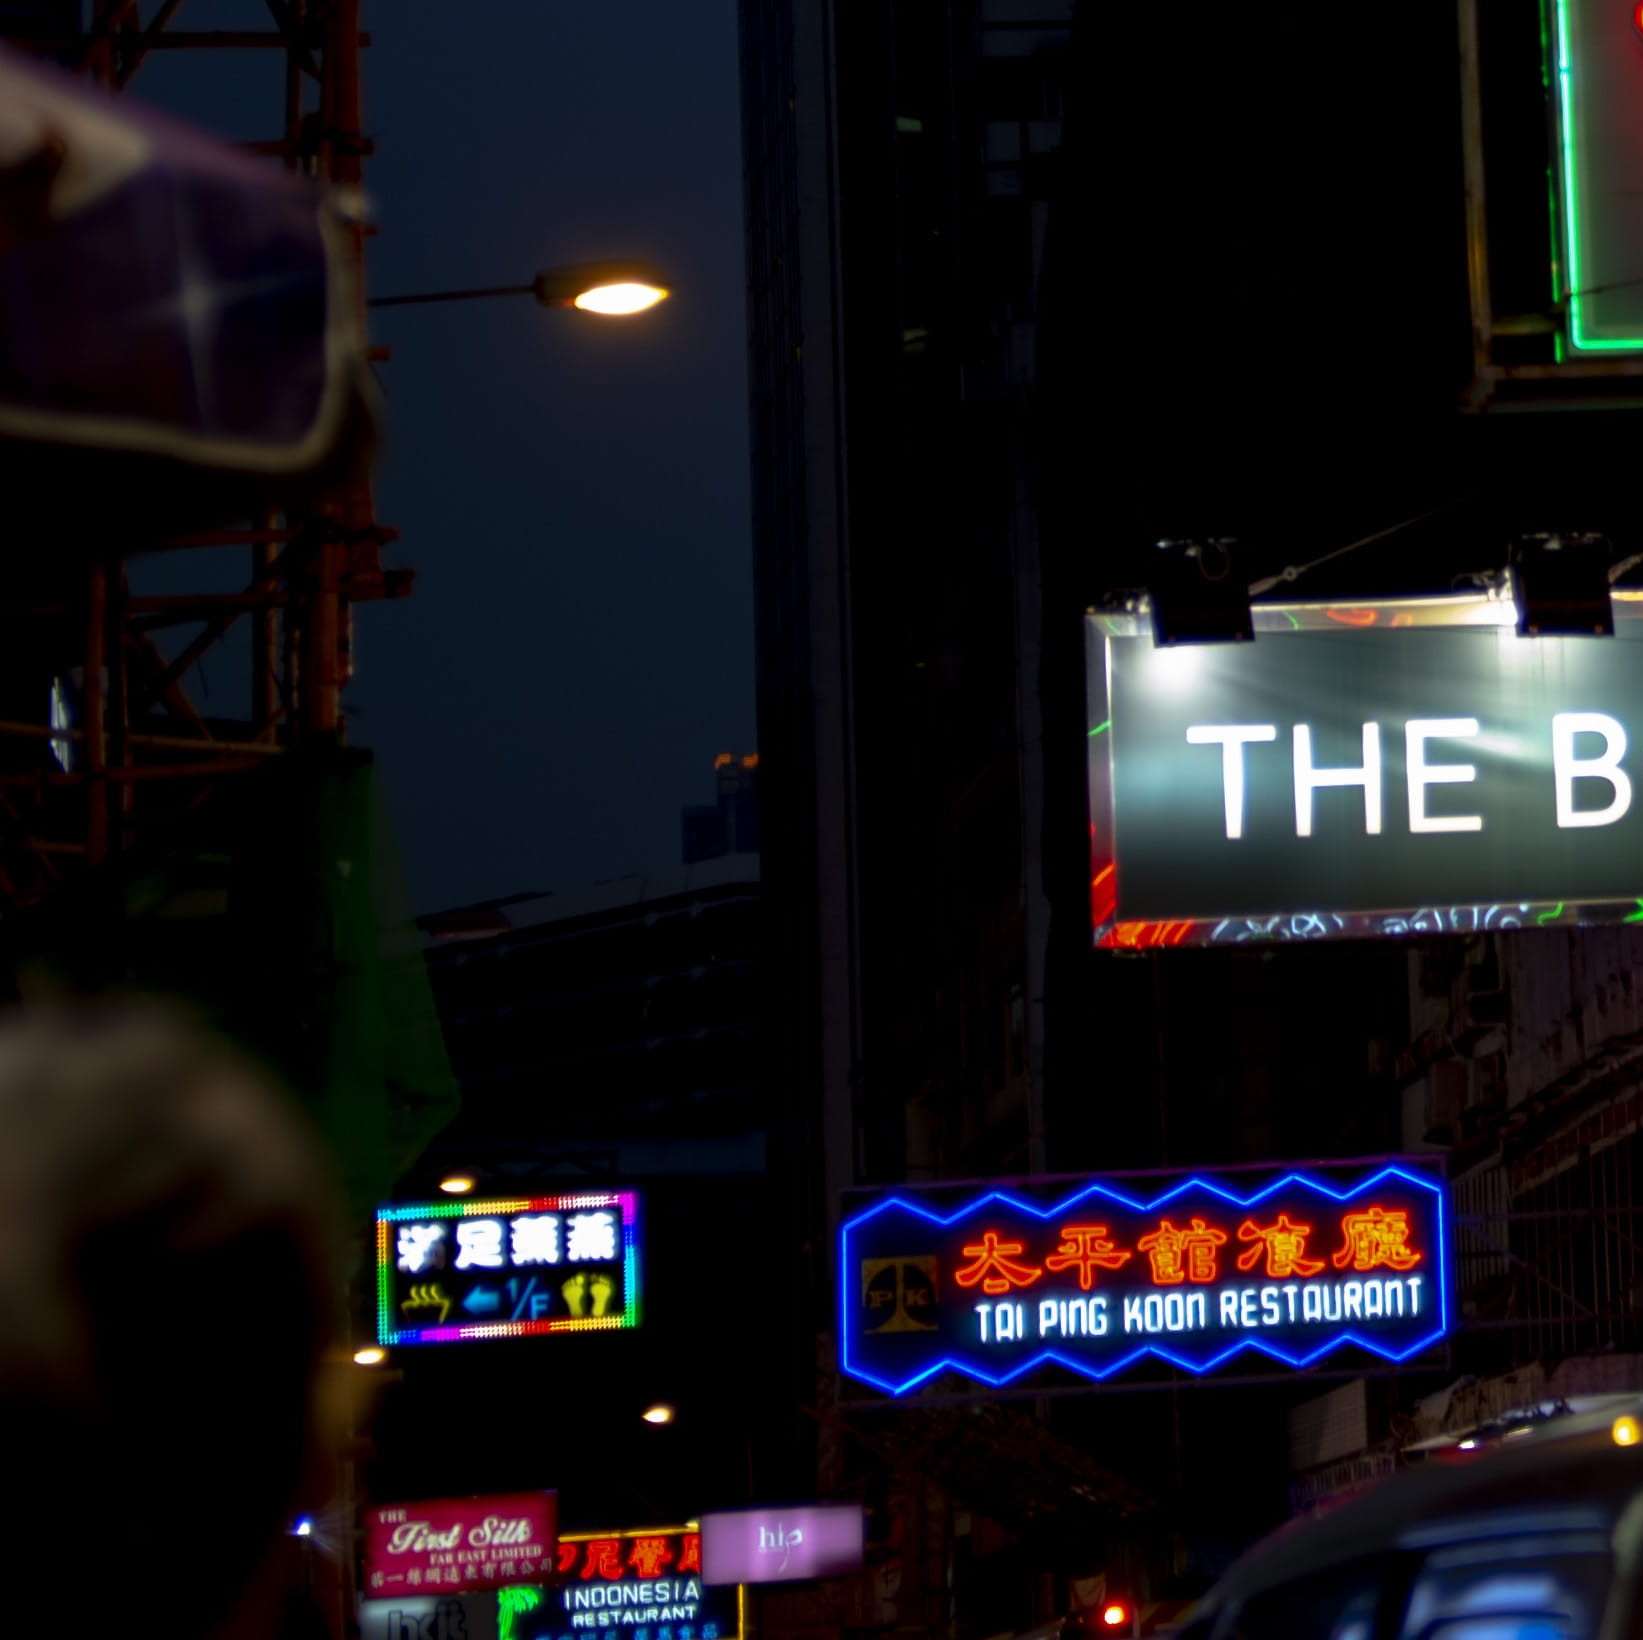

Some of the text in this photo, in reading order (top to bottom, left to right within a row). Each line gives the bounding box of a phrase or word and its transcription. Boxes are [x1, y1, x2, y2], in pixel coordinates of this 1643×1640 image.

[1186, 716, 1483, 840] THE
[975, 1277, 1422, 1343] TAI PING KOON RESTAURANT
[468, 1515, 532, 1548] Silk
[564, 1578, 700, 1611] INDONESIA
[572, 1604, 697, 1628] RESTAURANT
